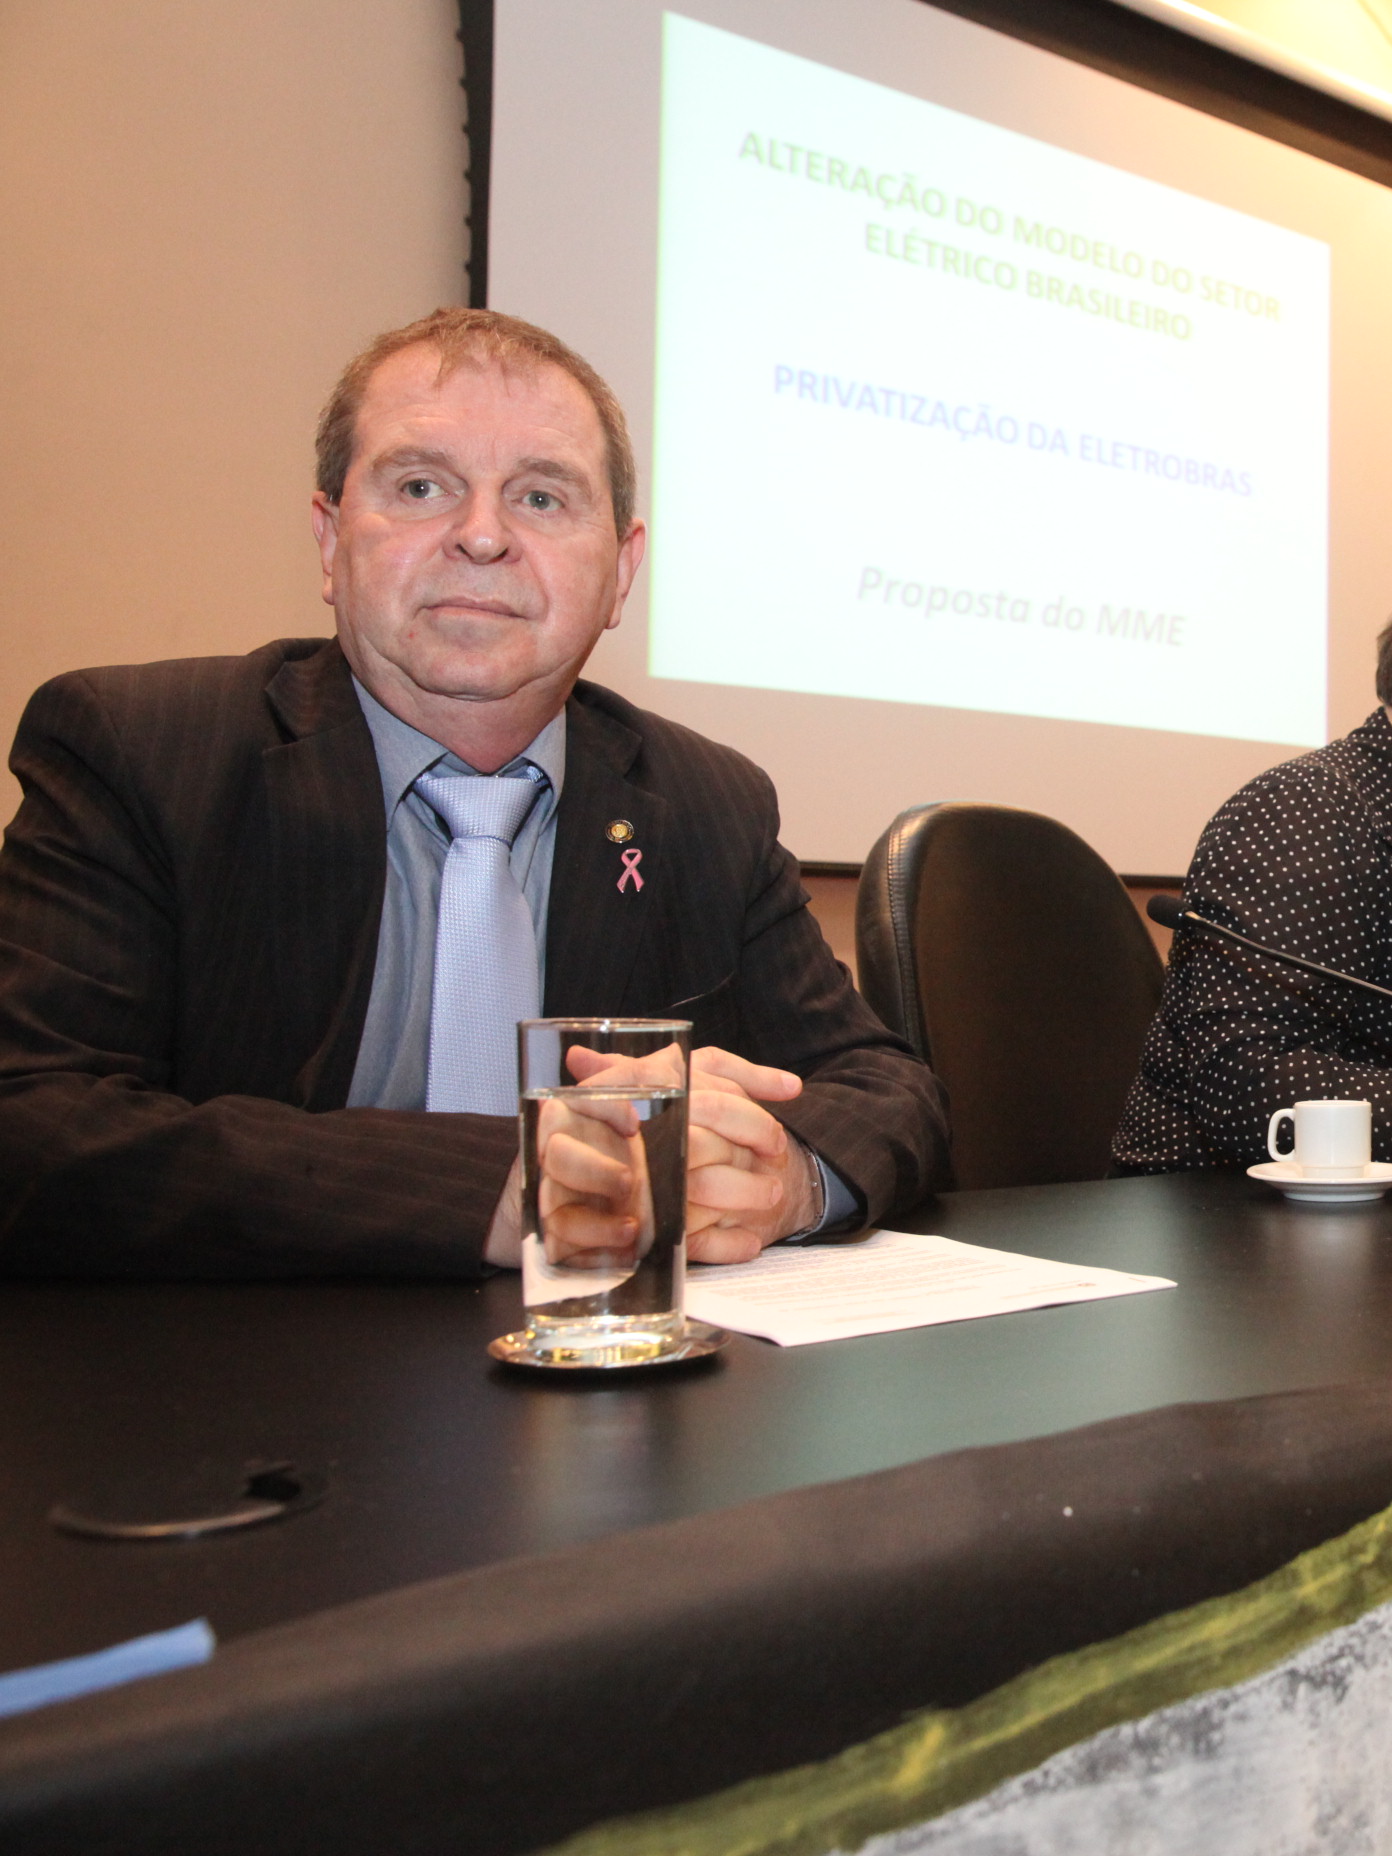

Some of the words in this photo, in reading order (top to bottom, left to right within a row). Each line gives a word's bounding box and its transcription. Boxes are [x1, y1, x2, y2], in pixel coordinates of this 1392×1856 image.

[739, 130, 947, 220] ALTERAÇÃO
[956, 198, 1003, 236] DO
[1013, 215, 1143, 281] MODELO
[1151, 260, 1195, 294] DO
[1200, 274, 1281, 322] SETOR
[865, 221, 1019, 290] ELÉTRICO
[1027, 271, 1195, 341] BRASILEIRO
[774, 364, 1019, 445] PRIVATIZAÇÃO
[1027, 421, 1071, 457] DA
[1080, 432, 1254, 498] ELETROBRAS
[858, 565, 1032, 626] Proposta
[1042, 595, 1086, 633] do
[1097, 603, 1187, 647] MME
